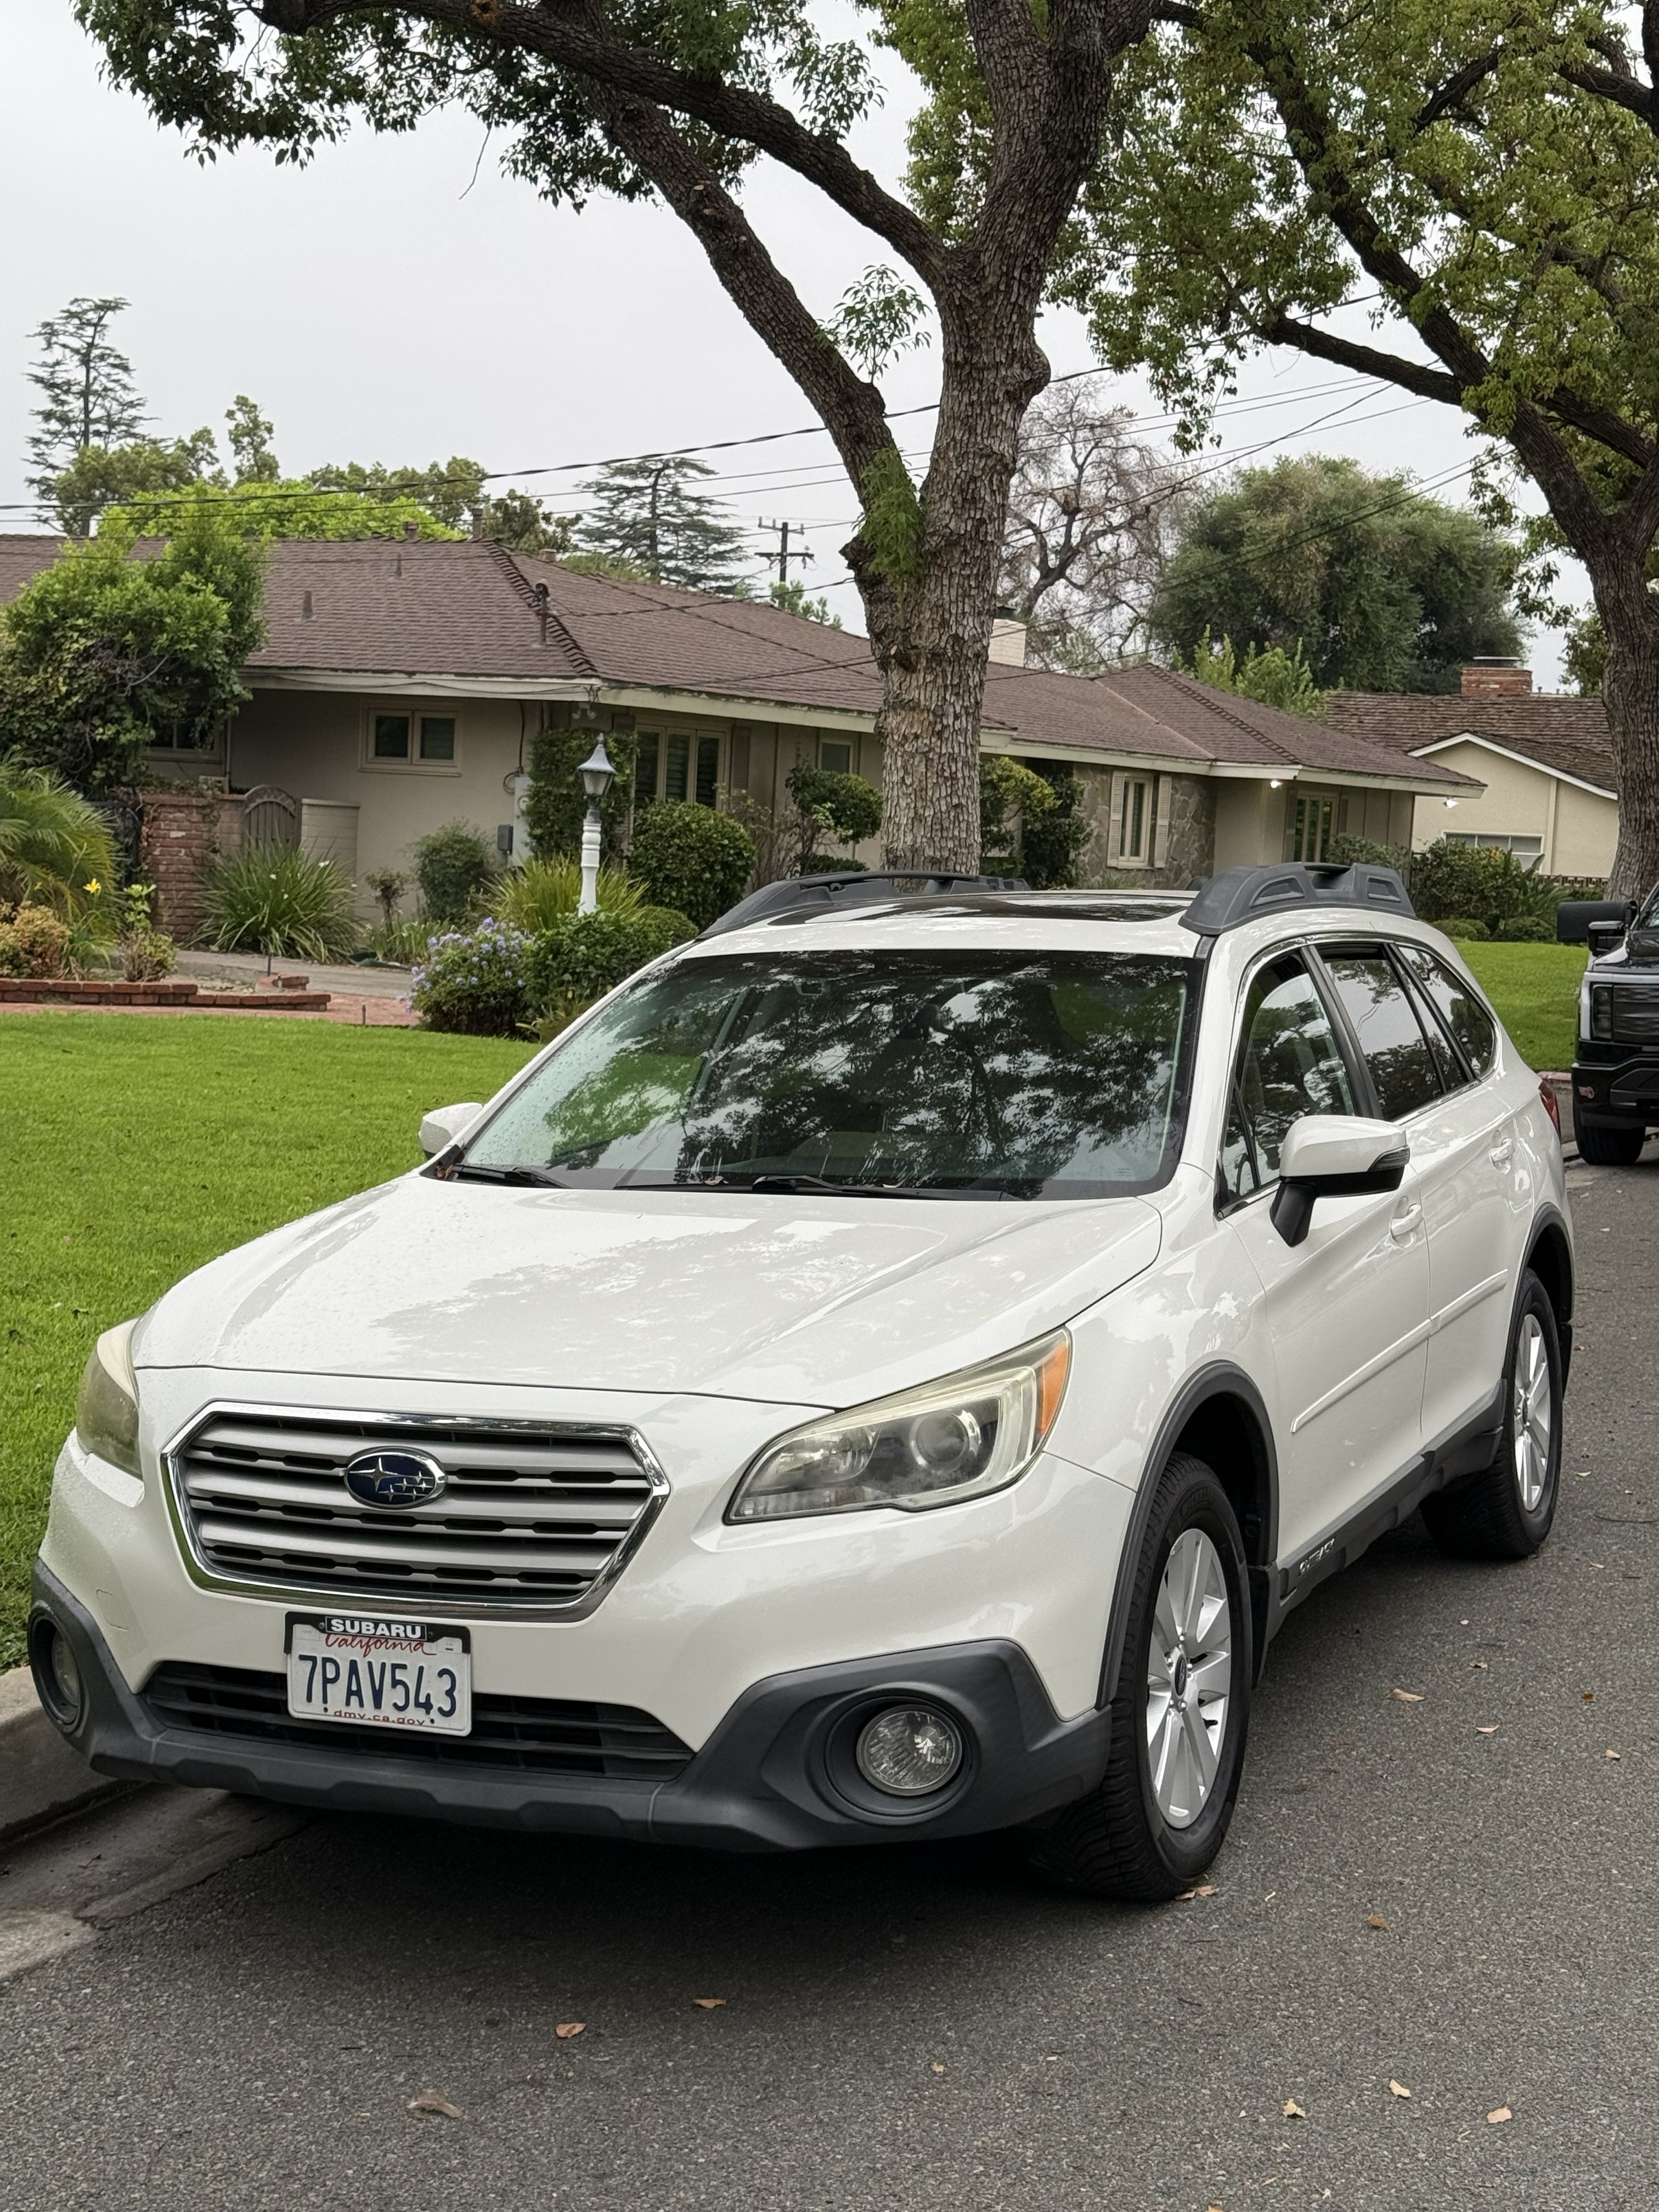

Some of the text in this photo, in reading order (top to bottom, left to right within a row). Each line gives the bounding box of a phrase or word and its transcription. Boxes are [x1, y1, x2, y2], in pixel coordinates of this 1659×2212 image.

[331, 1619, 421, 1639] SUBARU
[325, 1634, 437, 1657] California
[298, 1654, 456, 1718] 7PAV543
[334, 1709, 425, 1726] dmv.ca.gov
